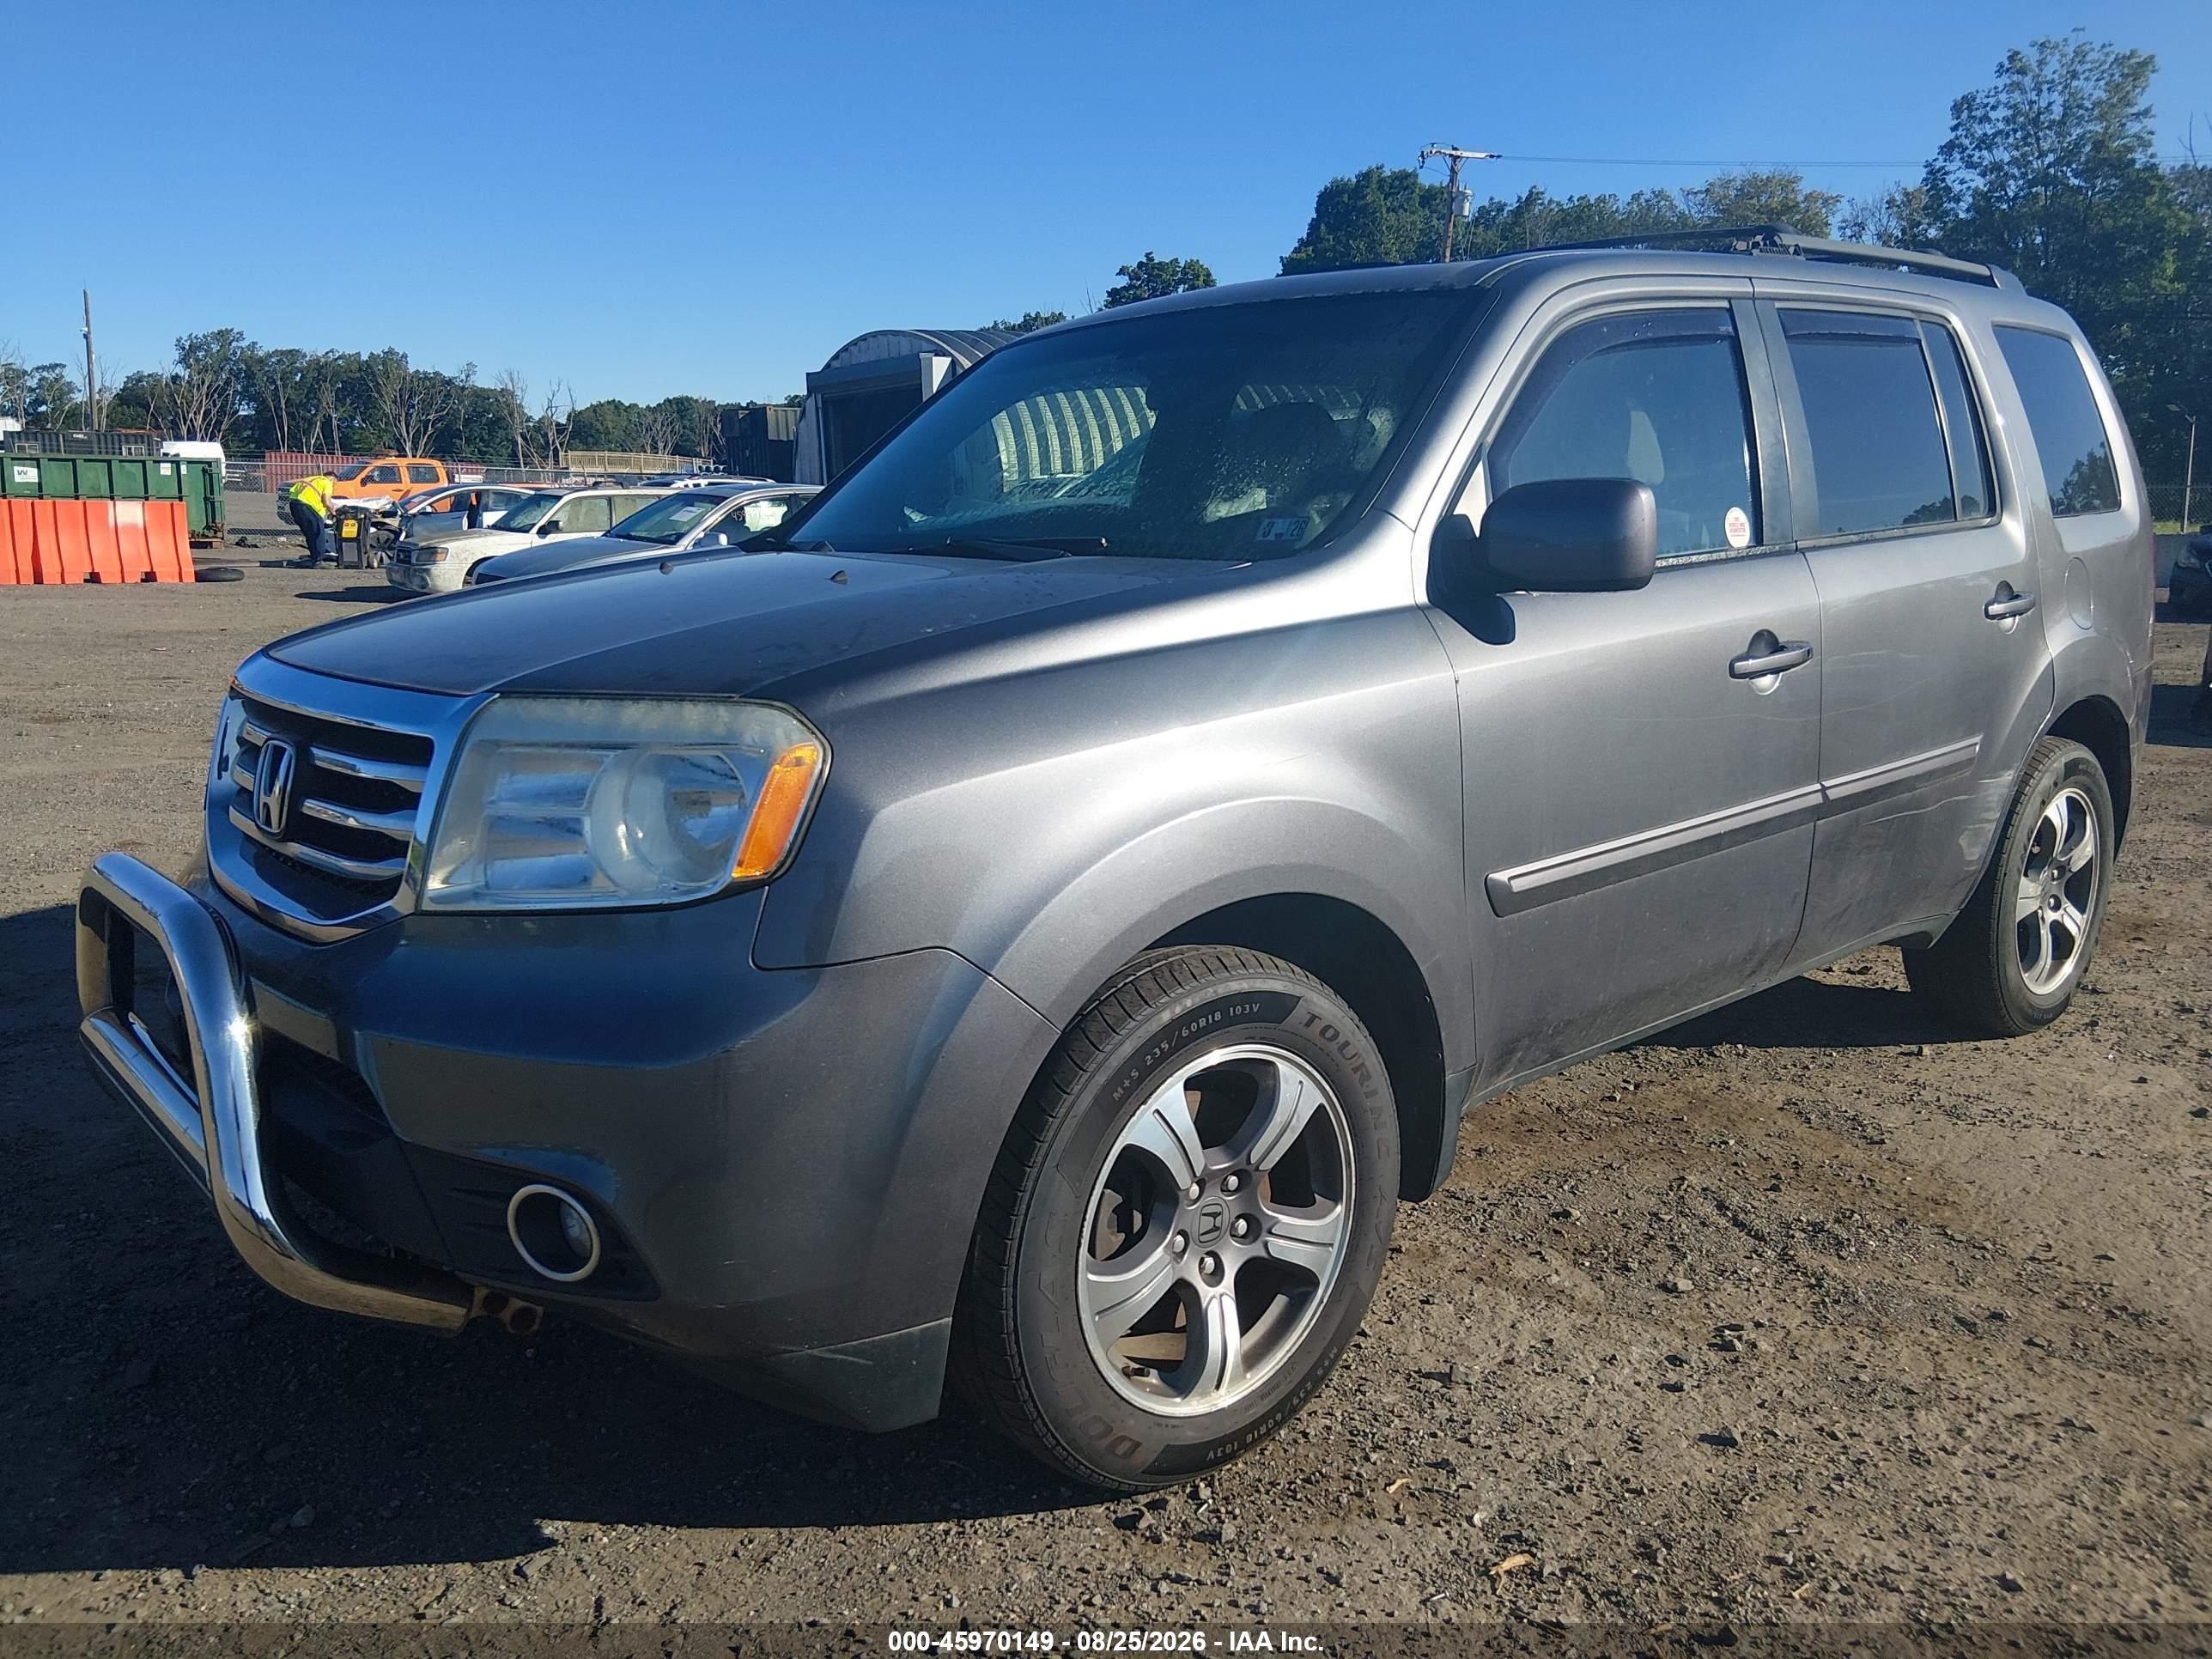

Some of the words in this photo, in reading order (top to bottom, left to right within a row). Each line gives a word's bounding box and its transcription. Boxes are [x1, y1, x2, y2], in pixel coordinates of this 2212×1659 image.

[1112, 1068, 1140, 1101] M+S
[1144, 1011, 1223, 1066] 235/60R18
[1229, 1002, 1261, 1018] 103V
[1299, 1010, 1390, 1161] TOURING
[1206, 1441, 1238, 1461] 103V
